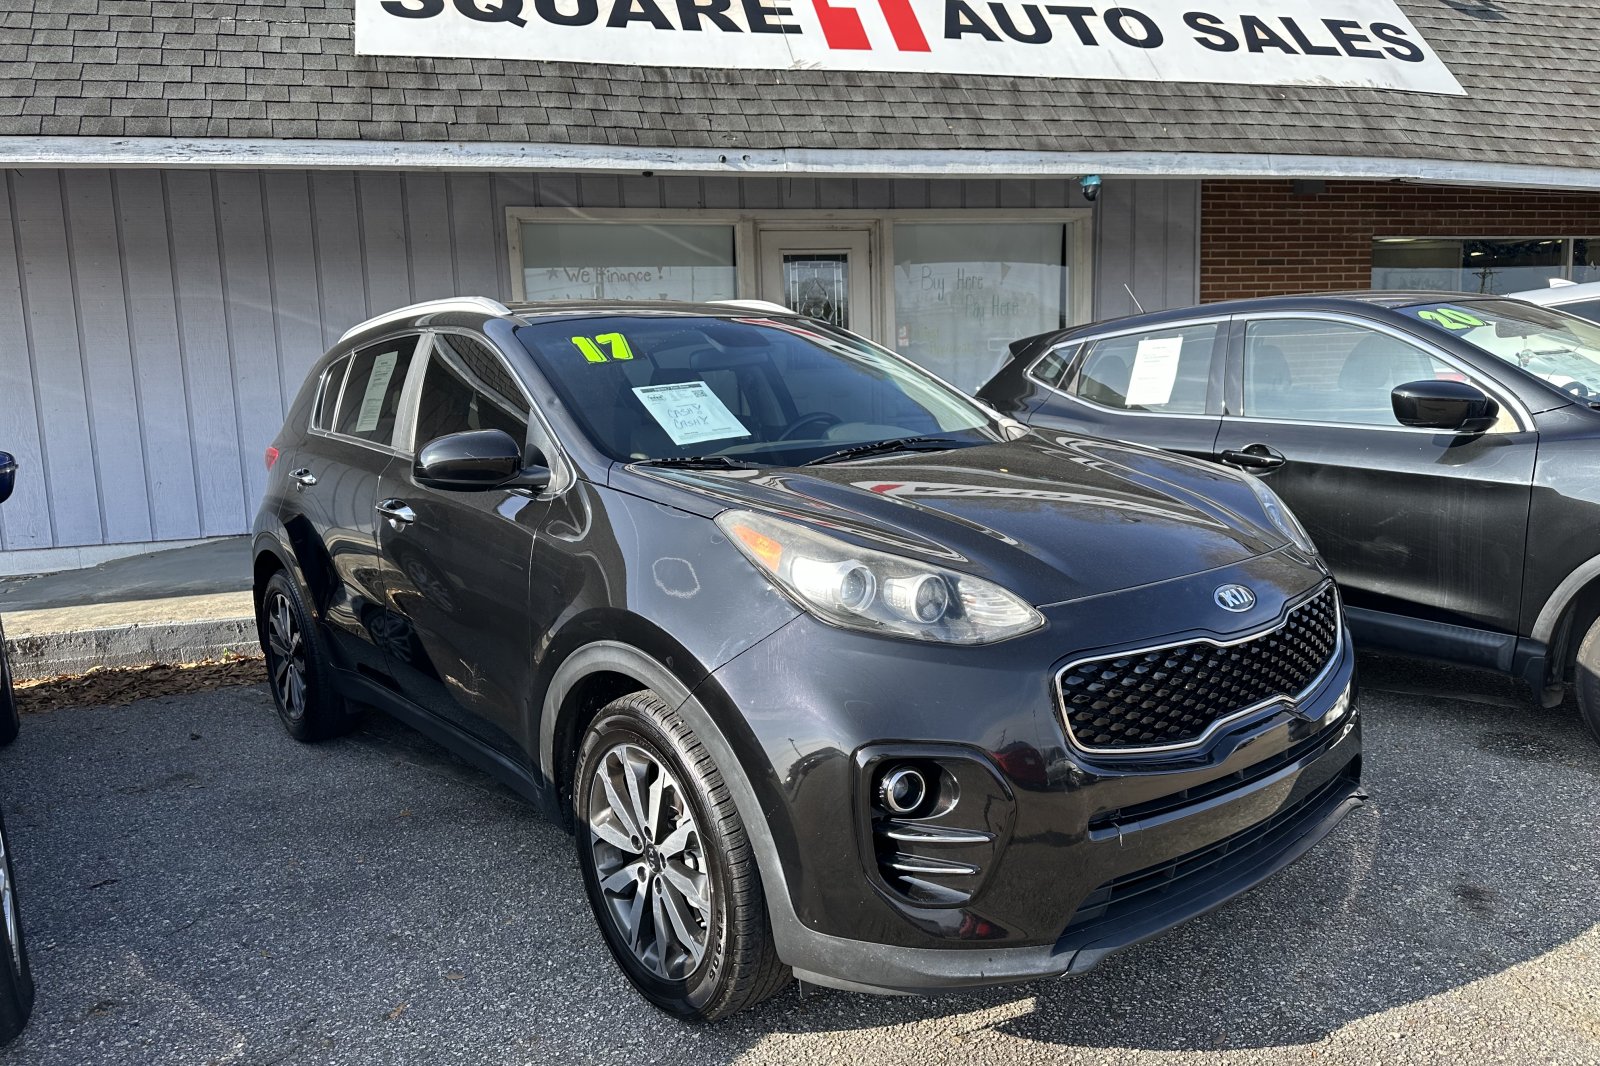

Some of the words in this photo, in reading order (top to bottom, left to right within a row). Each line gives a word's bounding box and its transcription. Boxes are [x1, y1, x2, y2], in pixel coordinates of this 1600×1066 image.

[944, 0, 1164, 49] AUTO
[1182, 12, 1425, 62] SALES
[563, 267, 591, 283] We
[1417, 308, 1487, 330] 20
[571, 332, 634, 363] 17
[1218, 587, 1253, 607] KIA
